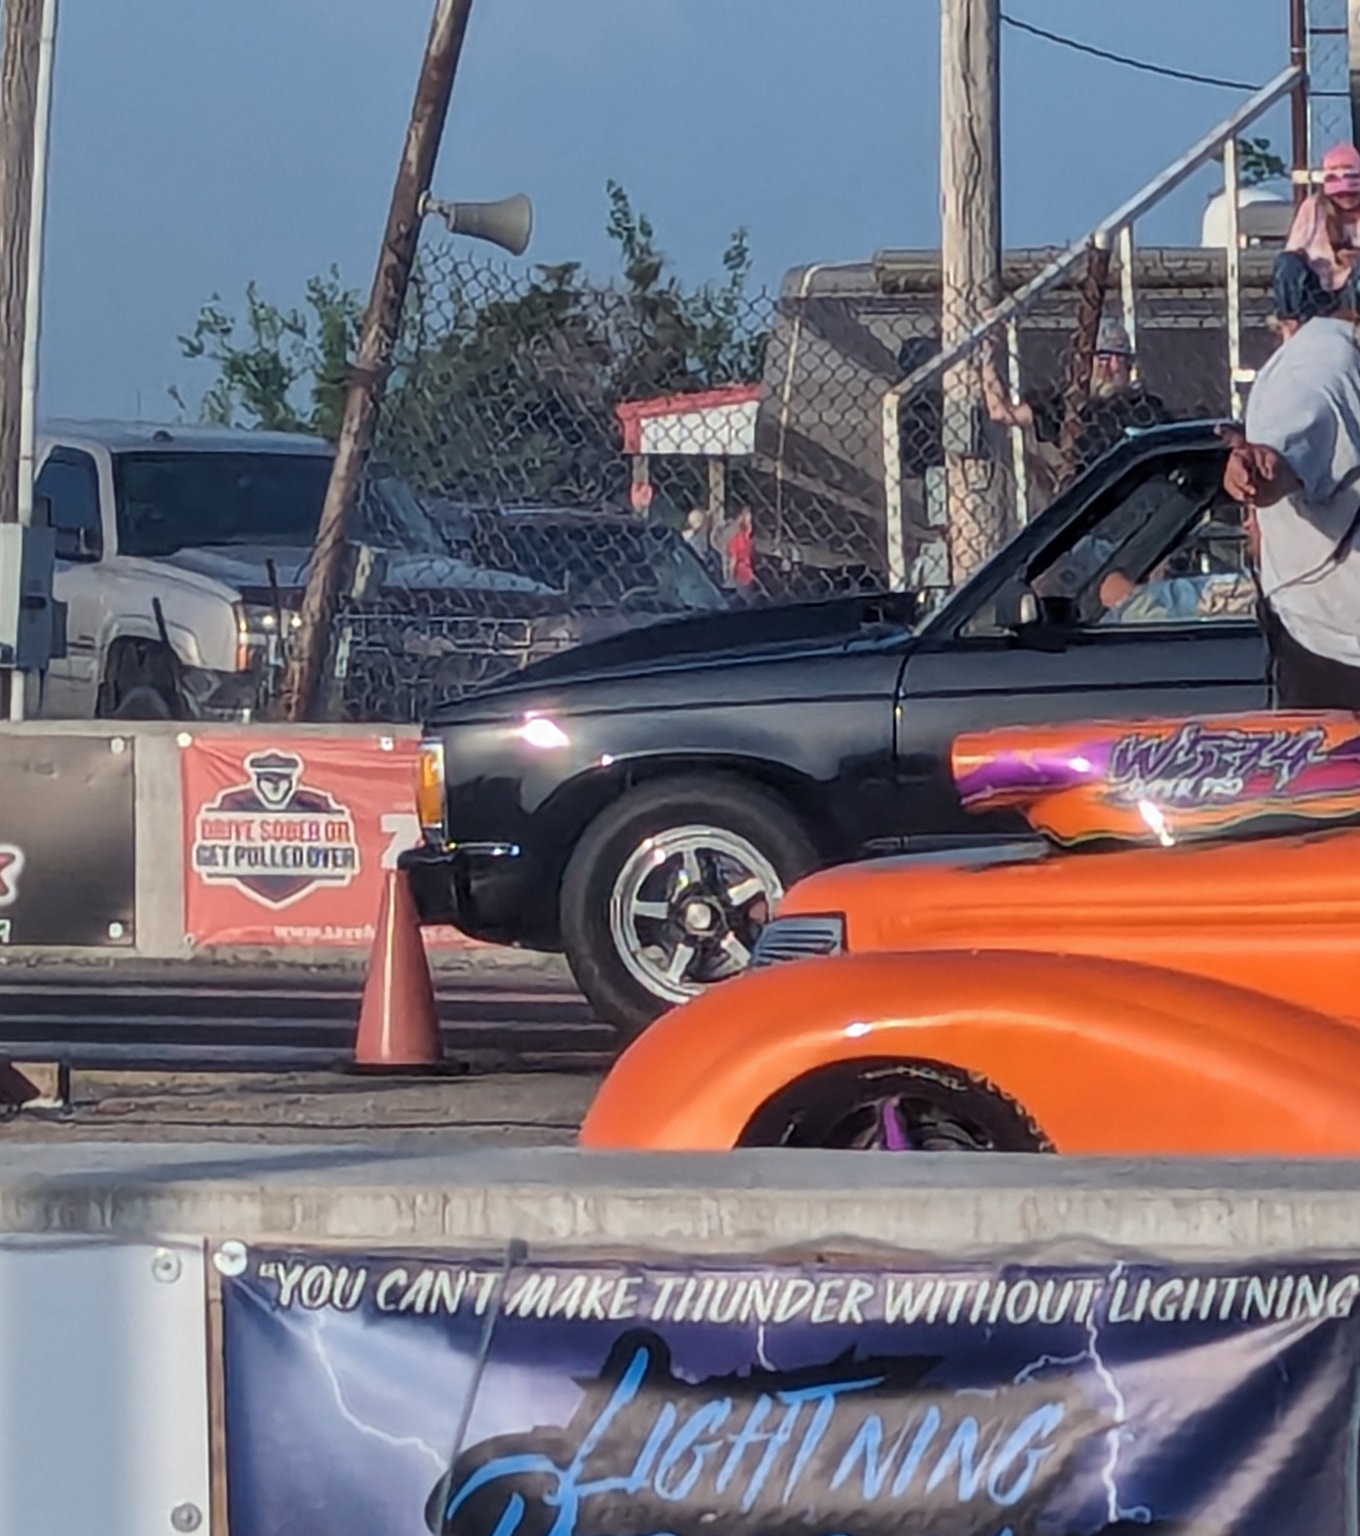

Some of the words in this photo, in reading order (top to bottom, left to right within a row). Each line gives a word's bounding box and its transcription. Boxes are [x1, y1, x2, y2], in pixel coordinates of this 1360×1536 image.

[196, 844, 230, 867] GET
[234, 845, 303, 868] PULLED
[306, 846, 355, 868] OVER
[376, 1266, 500, 1317] CAN'T
[504, 1272, 643, 1319] MAKE
[647, 1274, 876, 1324] THUNDER
[885, 1276, 1103, 1324] WITHOUT
